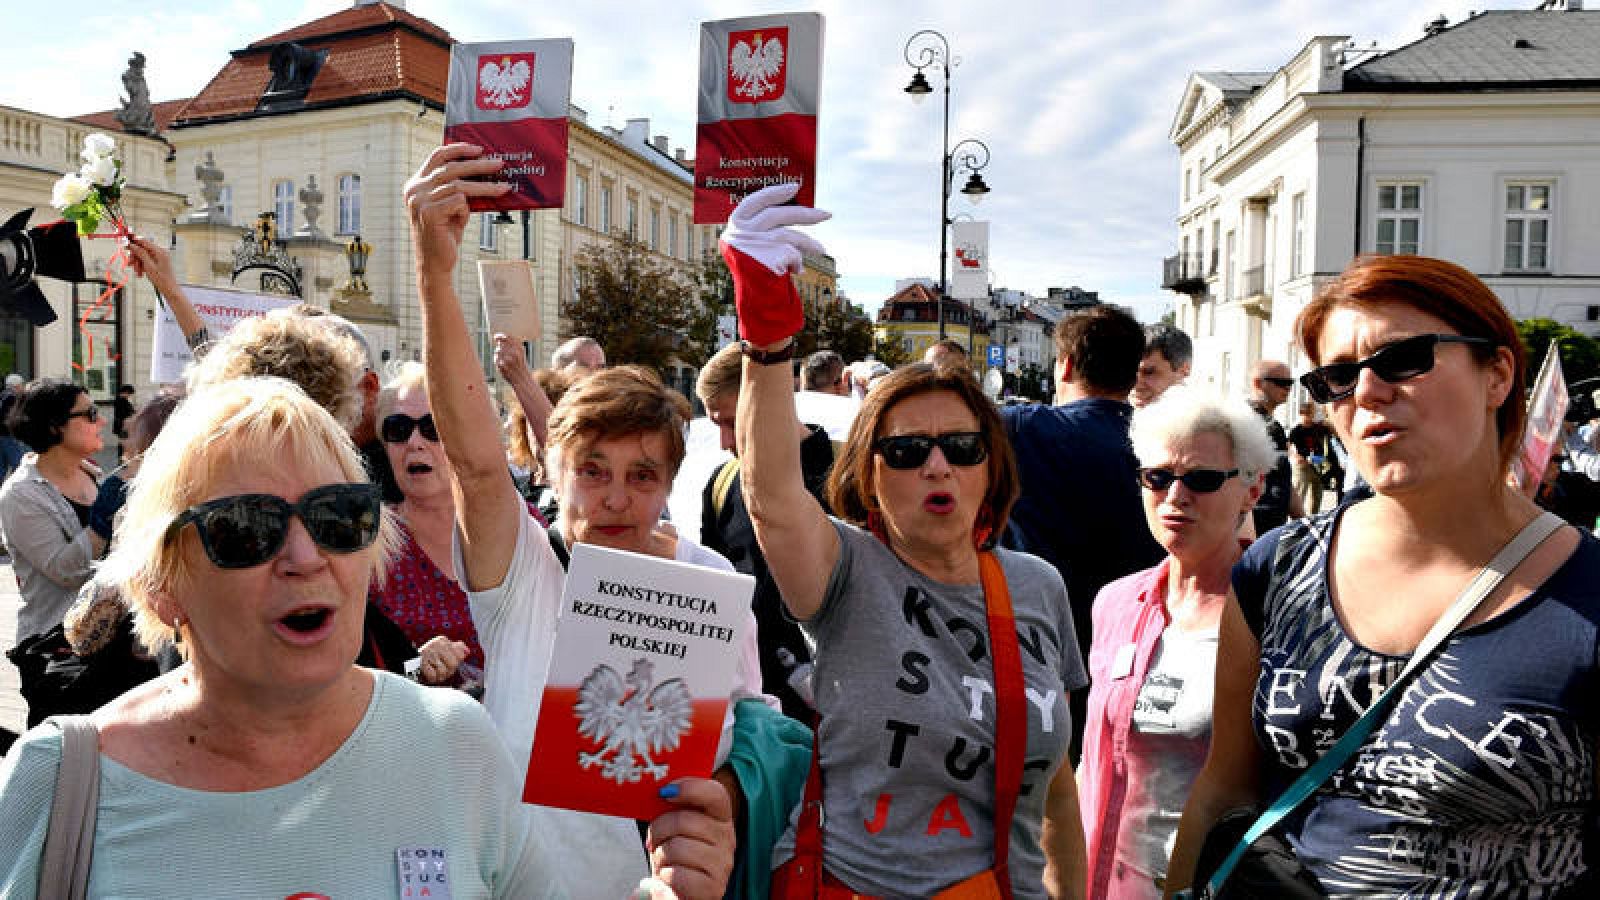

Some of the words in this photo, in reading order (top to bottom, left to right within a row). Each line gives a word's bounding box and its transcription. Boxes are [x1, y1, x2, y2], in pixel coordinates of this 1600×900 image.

[719, 155, 789, 170] Konstytucja
[705, 172, 803, 189] Rzeczypospolitej
[597, 579, 717, 615] KONSTYTUCJA
[572, 599, 734, 643] RZECZYPOSPOLITEJ
[609, 633, 687, 660] POLSKIEJ
[864, 792, 973, 838] JA
